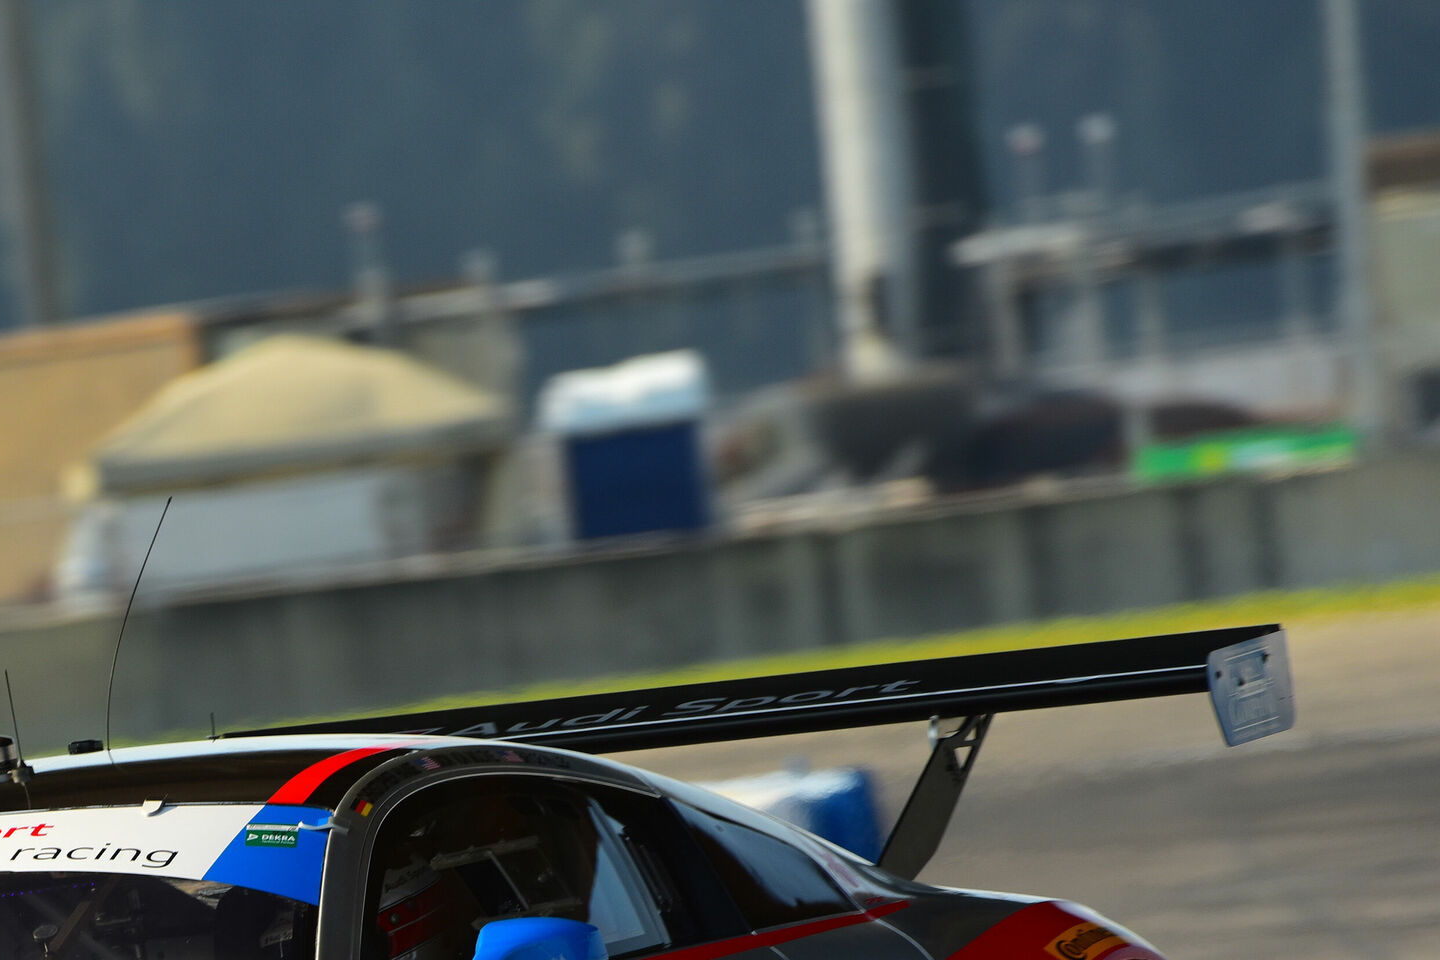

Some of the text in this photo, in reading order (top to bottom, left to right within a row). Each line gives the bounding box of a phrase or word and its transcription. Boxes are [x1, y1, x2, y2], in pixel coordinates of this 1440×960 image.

[449, 679, 923, 737] Audi Sport
[261, 834, 296, 842] DEKRA
[10, 843, 179, 868] racing
